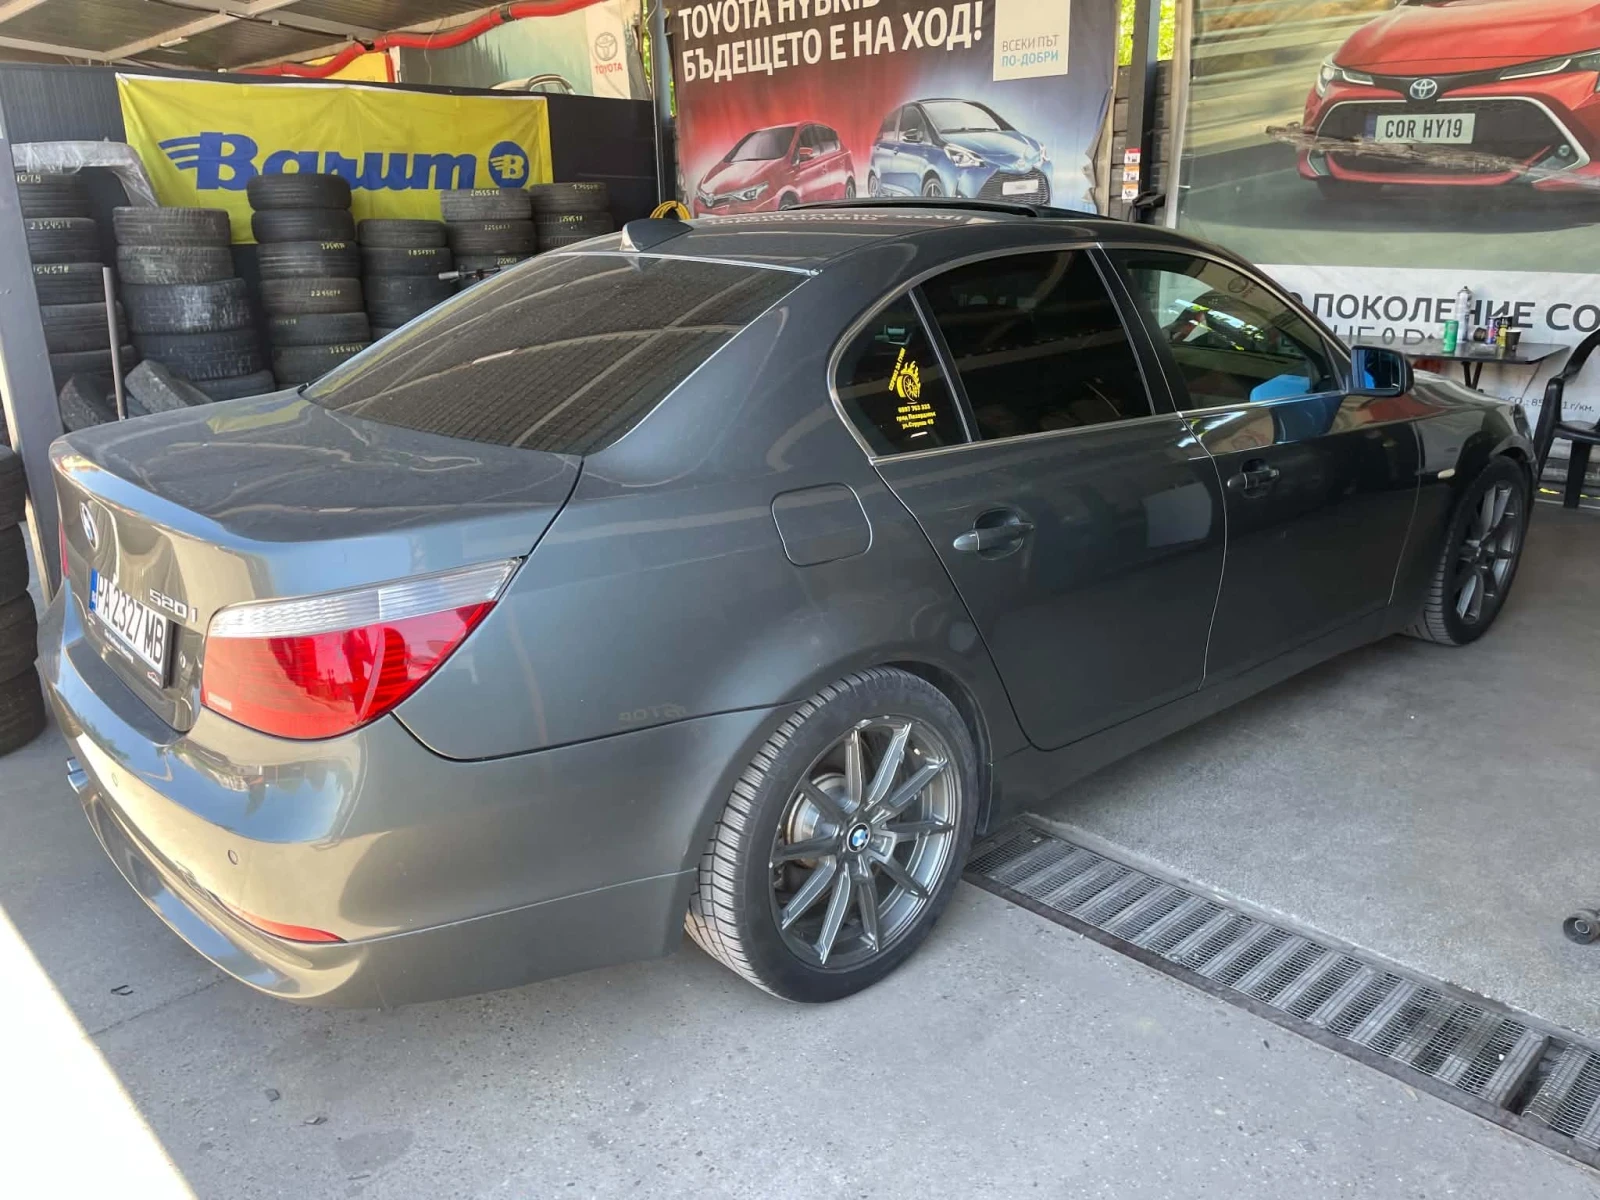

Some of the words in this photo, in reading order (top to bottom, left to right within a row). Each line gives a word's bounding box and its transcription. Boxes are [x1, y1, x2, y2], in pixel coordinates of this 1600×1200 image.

[678, 0, 771, 40] TOYOTA
[682, 28, 822, 83] БЪДЕЩЕТО
[829, 24, 846, 60] Е
[853, 16, 896, 57] НА
[901, 1, 983, 50] ХОД!
[1002, 37, 1035, 52] ВСЕКИ
[1037, 34, 1060, 48] ПЪТ
[595, 62, 623, 75] TOYOTA
[1002, 50, 1058, 67] ПО-ДОБРИ
[1385, 120, 1416, 138] COR
[1422, 119, 1463, 138] HY19
[158, 131, 477, 191] Barum
[97, 575, 110, 620] PA
[112, 587, 143, 645] 2327
[144, 609, 164, 664] MB
